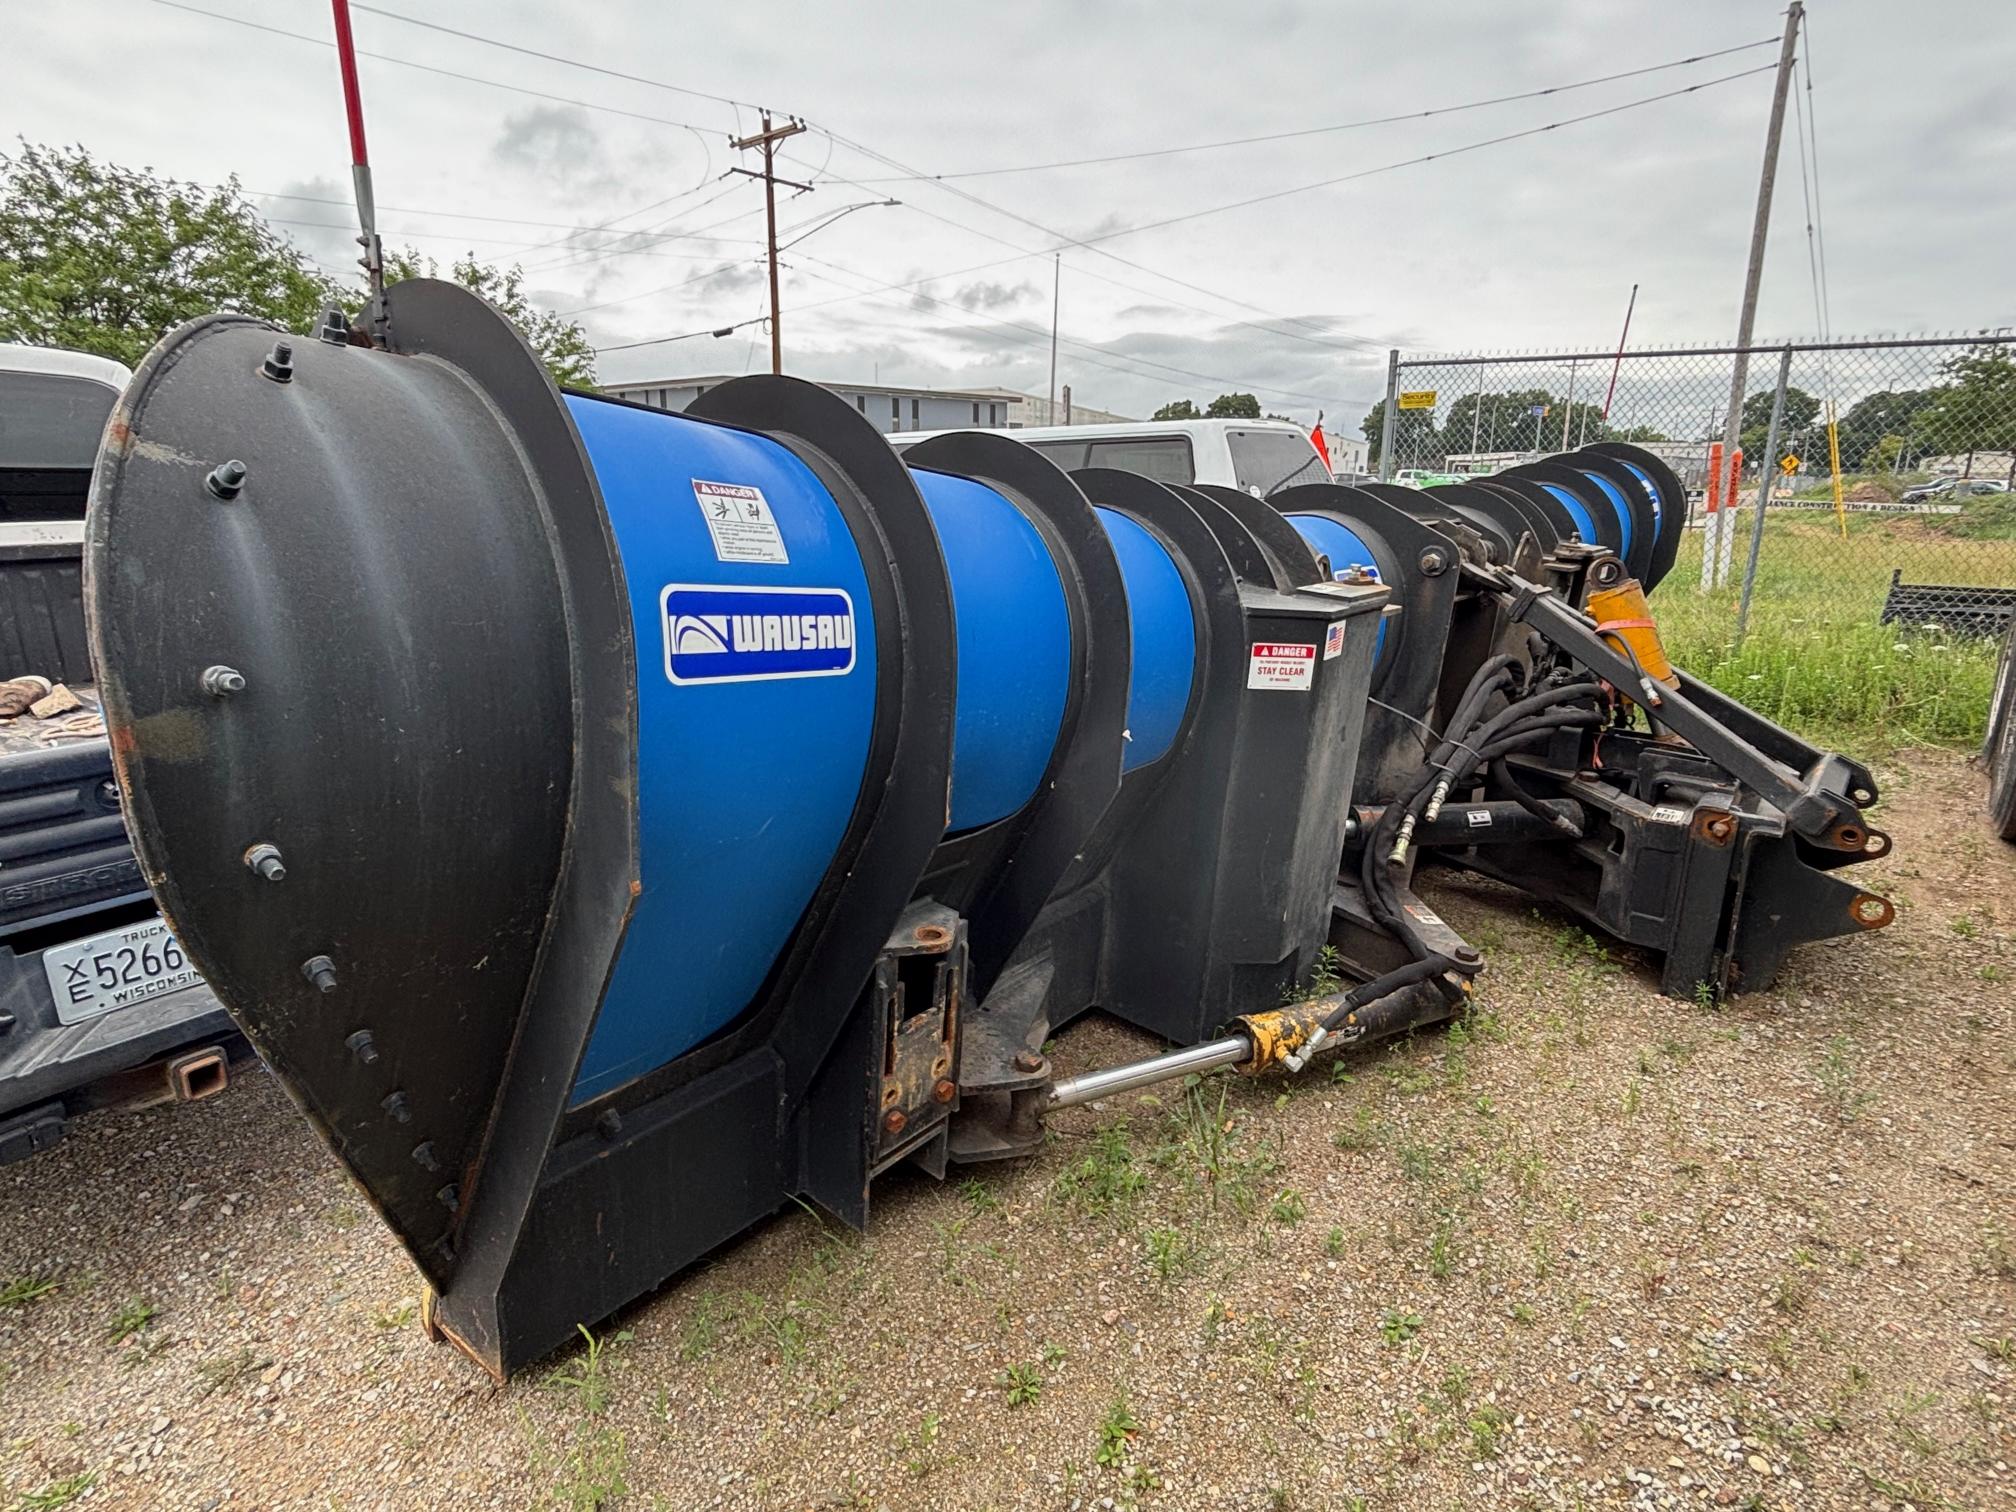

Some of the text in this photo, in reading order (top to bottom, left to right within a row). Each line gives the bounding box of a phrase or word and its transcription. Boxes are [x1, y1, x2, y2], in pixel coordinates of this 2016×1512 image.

[710, 485, 754, 499] DANGER
[732, 614, 852, 653] WAUSAU
[1271, 646, 1308, 657] DANGER
[1257, 666, 1305, 676] STAY CLEAR
[121, 923, 168, 944] TRUCK
